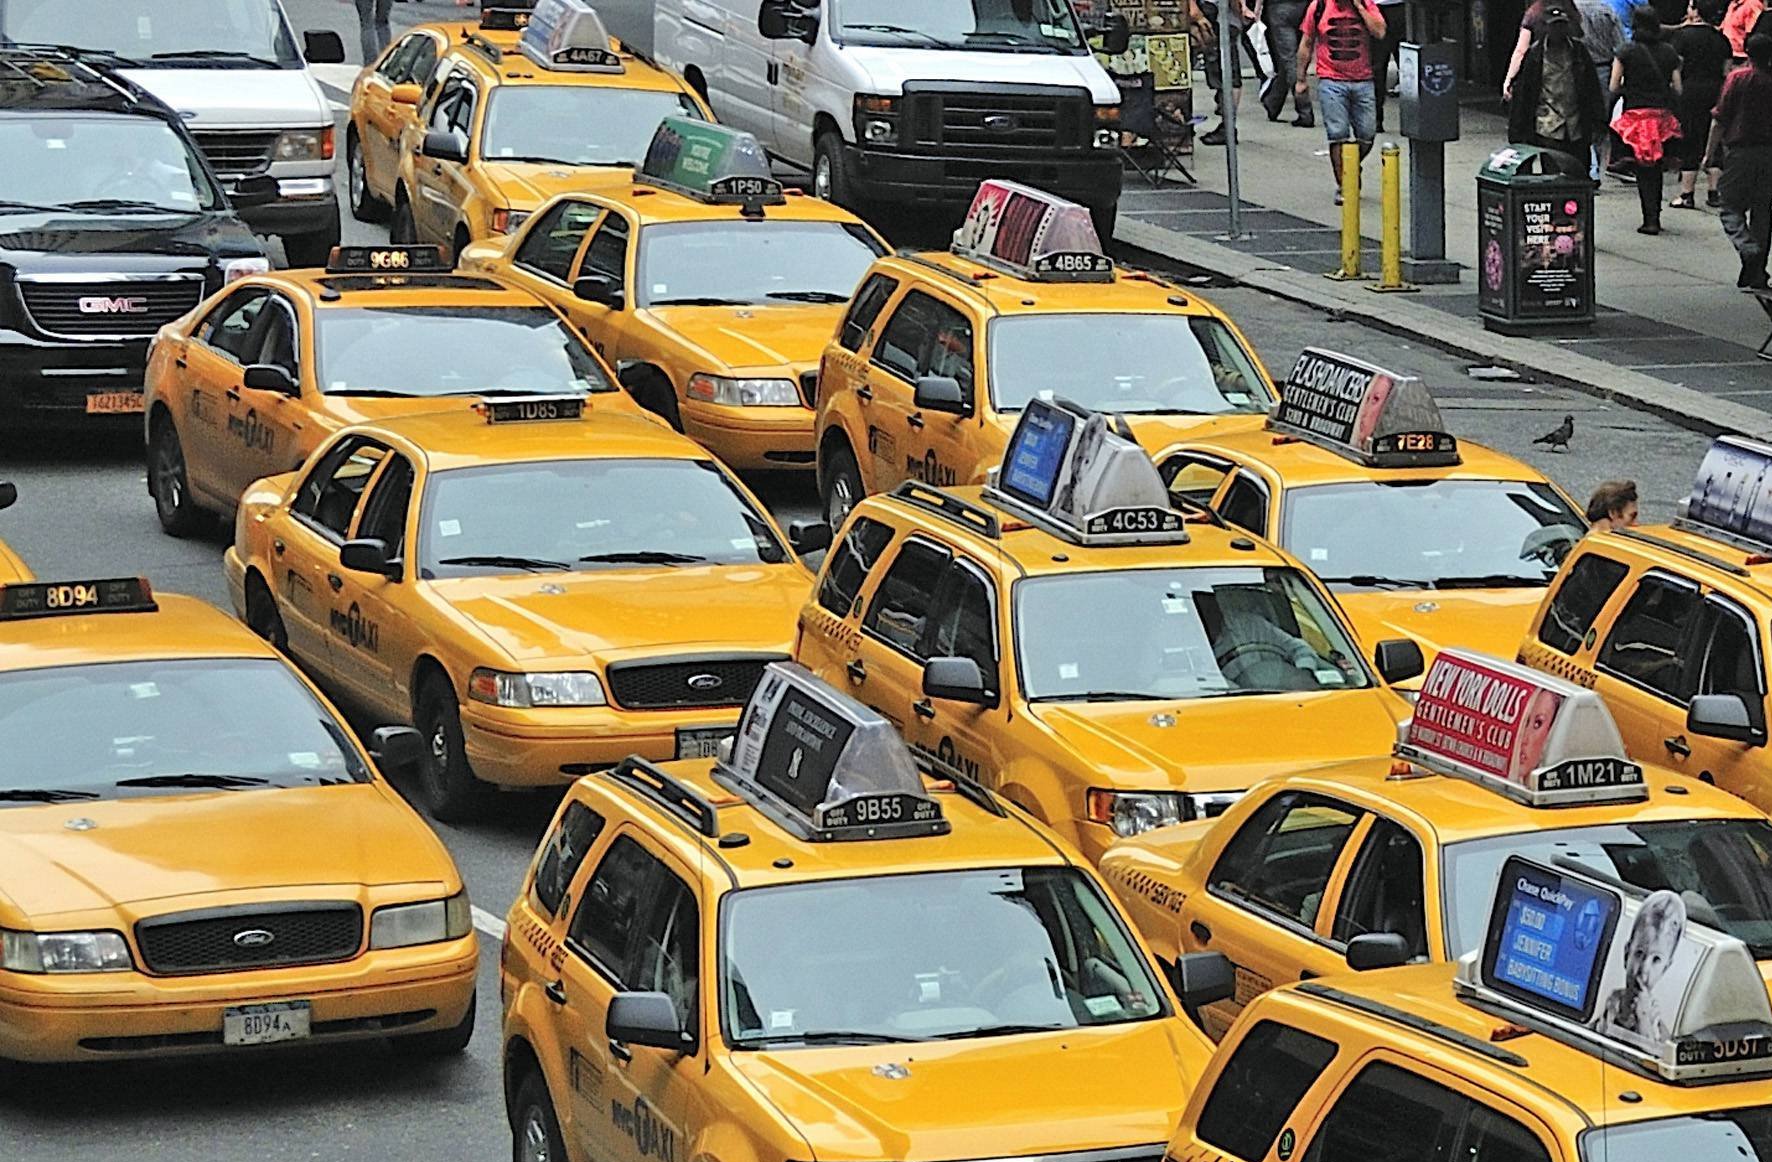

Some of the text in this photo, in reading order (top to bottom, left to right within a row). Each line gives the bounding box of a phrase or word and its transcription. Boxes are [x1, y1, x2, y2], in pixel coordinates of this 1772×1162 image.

[730, 180, 762, 194] 1P50
[1524, 203, 1552, 212] START
[1527, 214, 1550, 223] YOUR
[1526, 235, 1550, 245] HERE
[1055, 255, 1092, 270] 4B65
[79, 297, 148, 312] GMC
[1290, 355, 1373, 403] FLASHDANCERS
[518, 403, 557, 418] 1D85
[1284, 384, 1357, 424] GENTLEMEN'S CLUB
[1112, 511, 1158, 530] 4C53
[47, 584, 98, 608] 8D94
[1423, 659, 1528, 725] NEW YORK DOLLS
[1416, 699, 1484, 740] GENTLEMEN'S
[1486, 721, 1512, 749] CLUB
[1566, 762, 1615, 785] 1M21
[856, 798, 902, 821] 9B55
[914, 809, 936, 819] DUTY
[827, 816, 848, 826] DUTY
[1517, 877, 1575, 911] Chase QuickPay
[1515, 933, 1552, 962] JENNIFER
[1508, 959, 1580, 1001] BABYSITTING BONUS
[1680, 1051, 1706, 1062] DUTY
